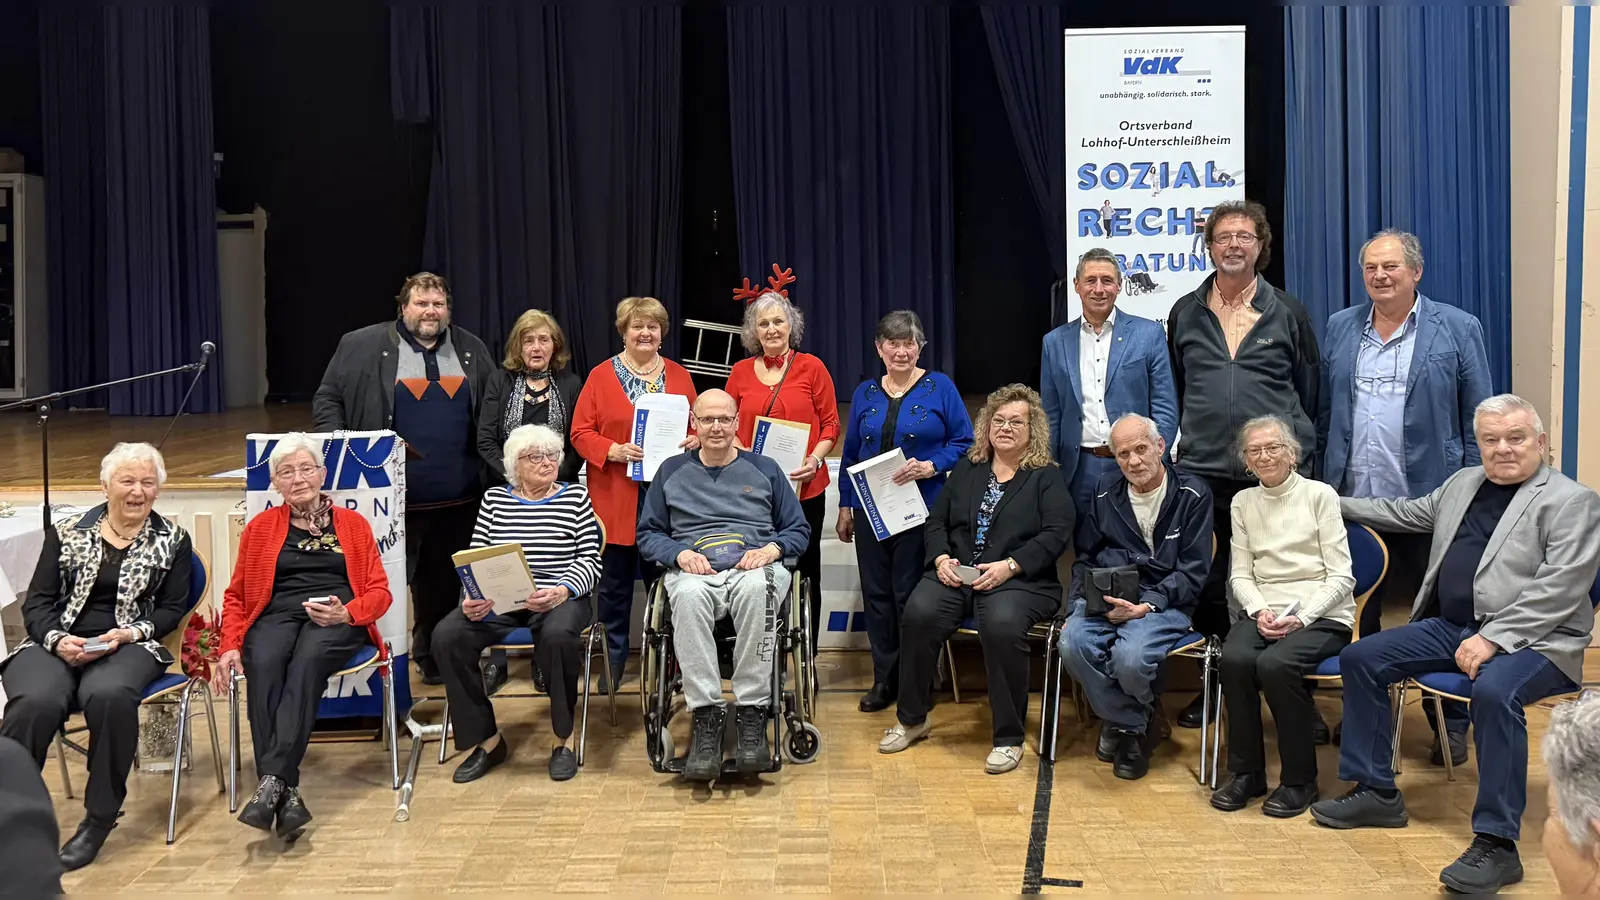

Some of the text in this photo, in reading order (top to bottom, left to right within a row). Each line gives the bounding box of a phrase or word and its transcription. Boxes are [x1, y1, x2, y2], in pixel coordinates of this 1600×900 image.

[1123, 56, 1183, 75] VdK
[1099, 89, 1212, 100] unabhängig. solidarisch. stark.
[1119, 120, 1193, 131] Ortsverband
[1081, 136, 1231, 149] Lohhof-Unterschleißheim
